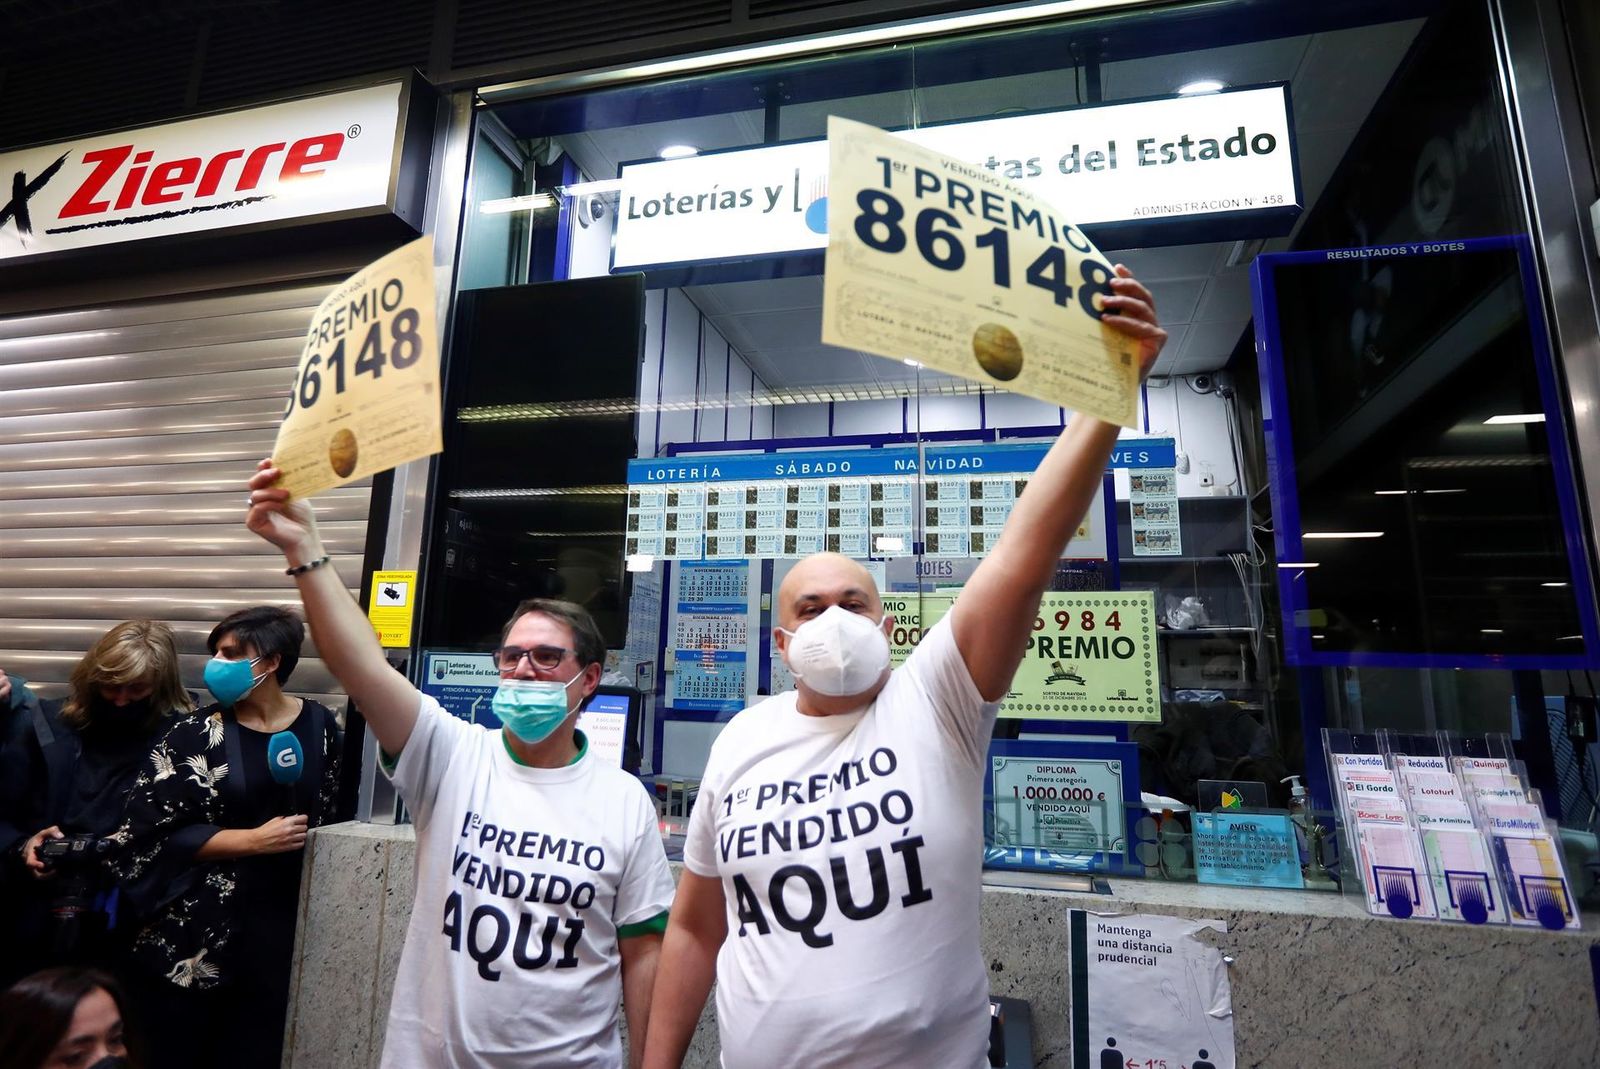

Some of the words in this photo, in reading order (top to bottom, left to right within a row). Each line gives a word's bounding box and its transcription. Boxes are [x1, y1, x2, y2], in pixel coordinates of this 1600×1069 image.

[57, 131, 346, 219] Zierre
[627, 183, 753, 220] Loterías
[762, 184, 784, 213] y
[978, 154, 1042, 180] tas
[1058, 140, 1117, 174] del
[1136, 125, 1277, 167] Estado
[940, 157, 1001, 188] VENDIDO
[1262, 194, 1284, 205] 458
[914, 167, 1092, 254] PREMIO
[853, 188, 1124, 322] 86148
[1326, 246, 1407, 260] RESULTADOS
[1410, 245, 1419, 254] Y
[1423, 242, 1465, 253] BOTES
[308, 278, 404, 357] PREMIO
[647, 464, 721, 480] LOTERÍA
[775, 459, 852, 475] SÁBADO
[894, 456, 984, 470] NAVIDAD
[1110, 451, 1149, 463] VES
[916, 560, 953, 575] BOTES
[883, 601, 906, 612] MIO
[1032, 610, 1121, 631] 6984
[1023, 635, 1136, 660] PREMIO
[1345, 757, 1357, 765] Con
[1358, 758, 1382, 766] Partidos
[1408, 759, 1444, 769] Reducidas
[1474, 760, 1508, 769] Quinigol
[1036, 766, 1076, 774] DIPLOMA
[756, 747, 897, 810] PREMIO
[1027, 775, 1054, 783] Primera
[1013, 786, 1093, 801] 1.000.000
[1421, 788, 1454, 796] Lototurf
[1026, 804, 1066, 812] VENDIDO
[719, 789, 914, 863] VENDIDO
[1230, 823, 1256, 832] AVISO
[1440, 816, 1471, 825] Primitiva
[1496, 818, 1540, 830] EuroMillones
[478, 823, 605, 871] PREMIO
[452, 844, 596, 910] VENDIDO
[732, 828, 933, 949] AQUÍ
[1097, 924, 1152, 939] Mantenga
[1098, 938, 1118, 948] una
[1122, 940, 1172, 954] distancia
[1098, 952, 1157, 966] prudencial
